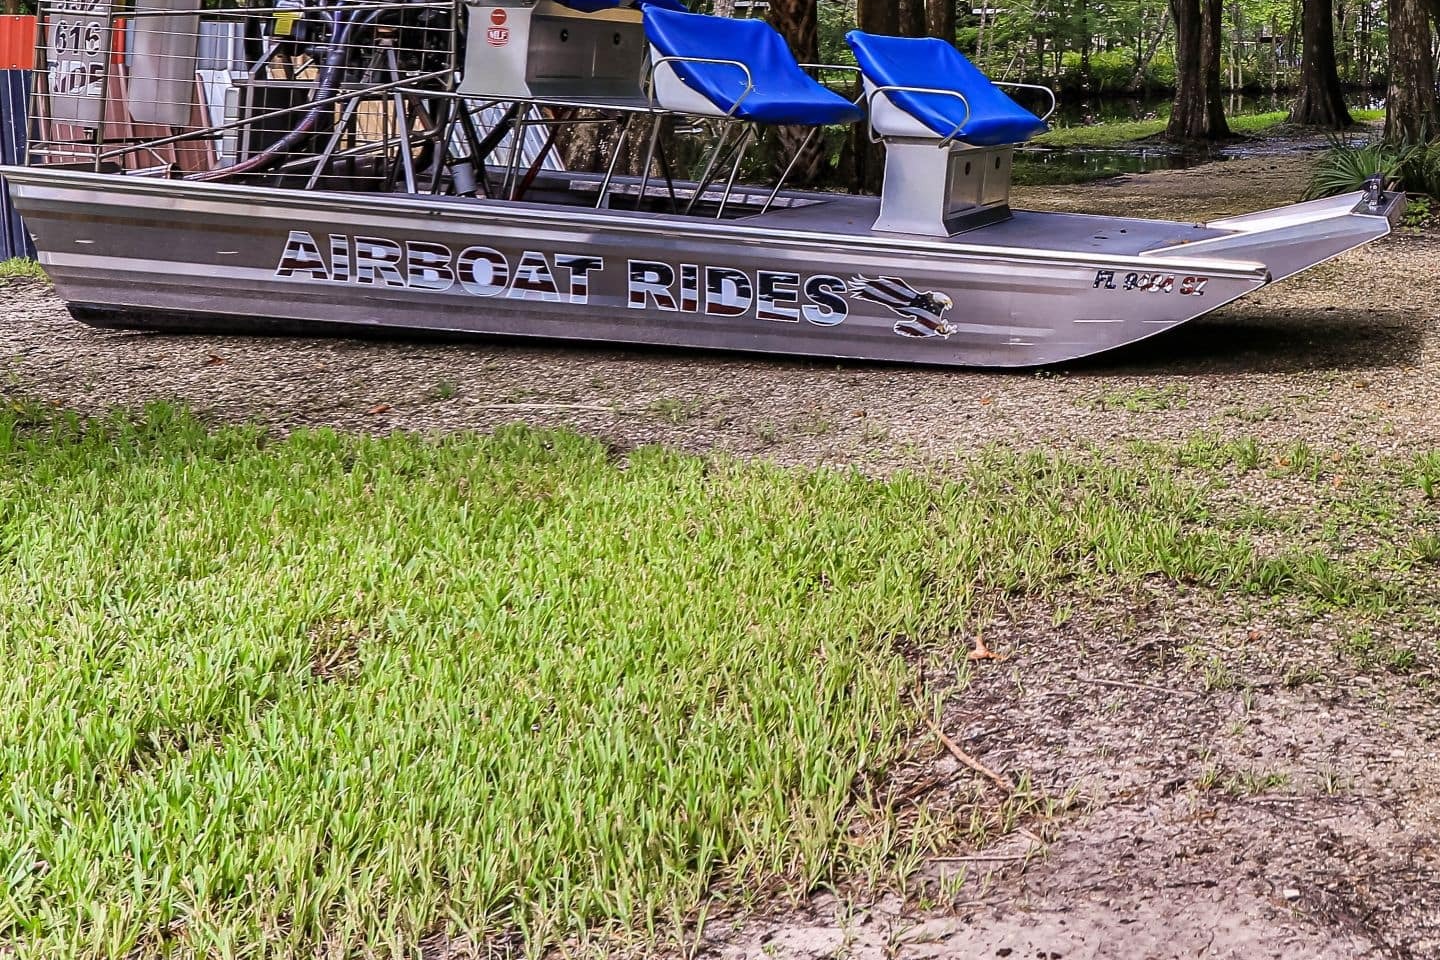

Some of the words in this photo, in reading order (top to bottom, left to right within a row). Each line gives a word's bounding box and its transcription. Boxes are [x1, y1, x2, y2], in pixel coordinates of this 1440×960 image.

[54, 20, 102, 55] 616
[274, 230, 604, 305] AIRBOAT
[627, 258, 851, 327] RIDES
[1092, 270, 1117, 290] FL
[1179, 276, 1209, 296] SZ
